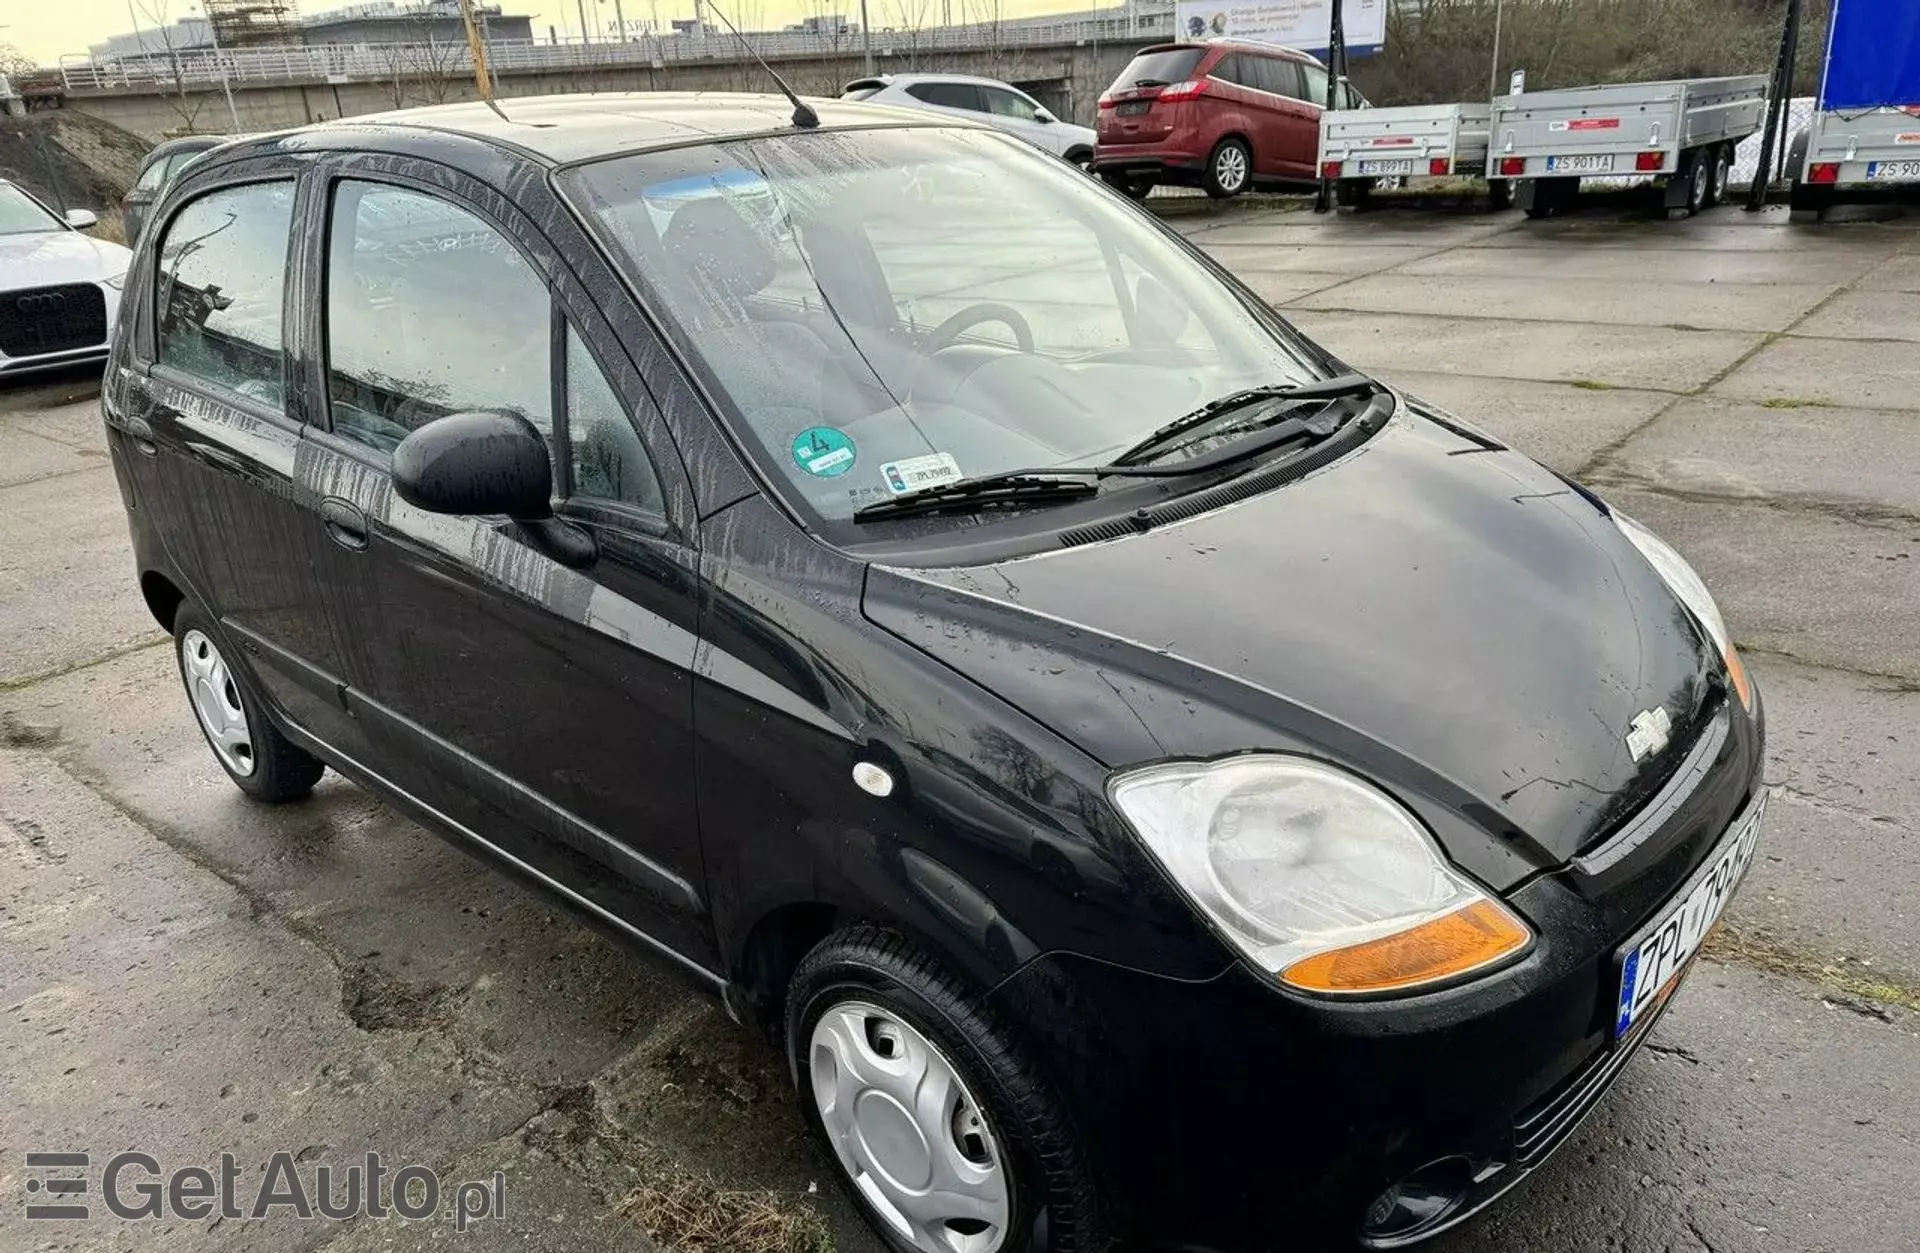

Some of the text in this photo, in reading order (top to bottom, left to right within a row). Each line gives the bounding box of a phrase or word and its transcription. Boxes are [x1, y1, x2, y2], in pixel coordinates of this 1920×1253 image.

[1556, 156, 1570, 169] ZS
[1877, 163, 1897, 176] ZS
[810, 430, 830, 452] 4
[1635, 908, 1687, 1011] ZPL
